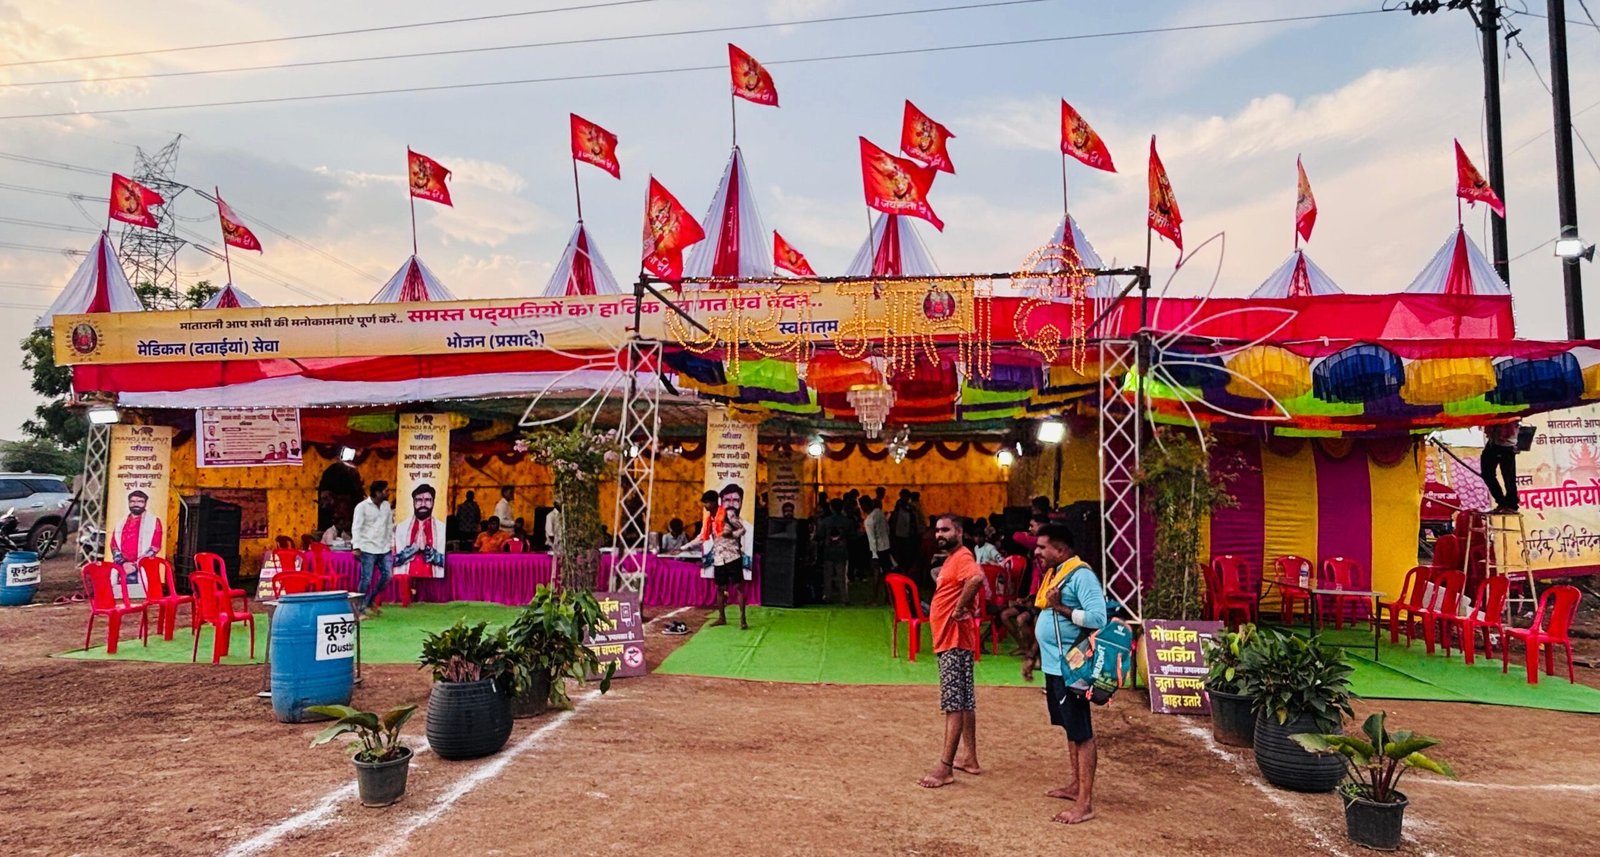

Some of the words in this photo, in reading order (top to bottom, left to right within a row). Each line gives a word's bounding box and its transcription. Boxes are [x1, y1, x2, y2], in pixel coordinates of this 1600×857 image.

[180, 318, 223, 331] मातारानी
[225, 319, 248, 329] आप
[250, 316, 272, 328] सभी
[273, 316, 289, 328] की
[291, 315, 354, 327] मनोकामनाएं
[357, 315, 376, 328] पूर्ण
[407, 308, 465, 323] समस्त
[568, 304, 595, 317] का
[137, 340, 186, 357] मेडिकल
[189, 337, 249, 357] (दवाईयां)
[252, 336, 280, 353] सेवा
[447, 332, 486, 348] भोजन
[1547, 416, 1582, 429] मातारानी
[1535, 433, 1548, 446] की
[1549, 432, 1597, 446] मनोकामनाएं
[1154, 677, 1175, 693] जूता
[1175, 678, 1205, 690] चप्पल
[1162, 694, 1182, 708] बाहर
